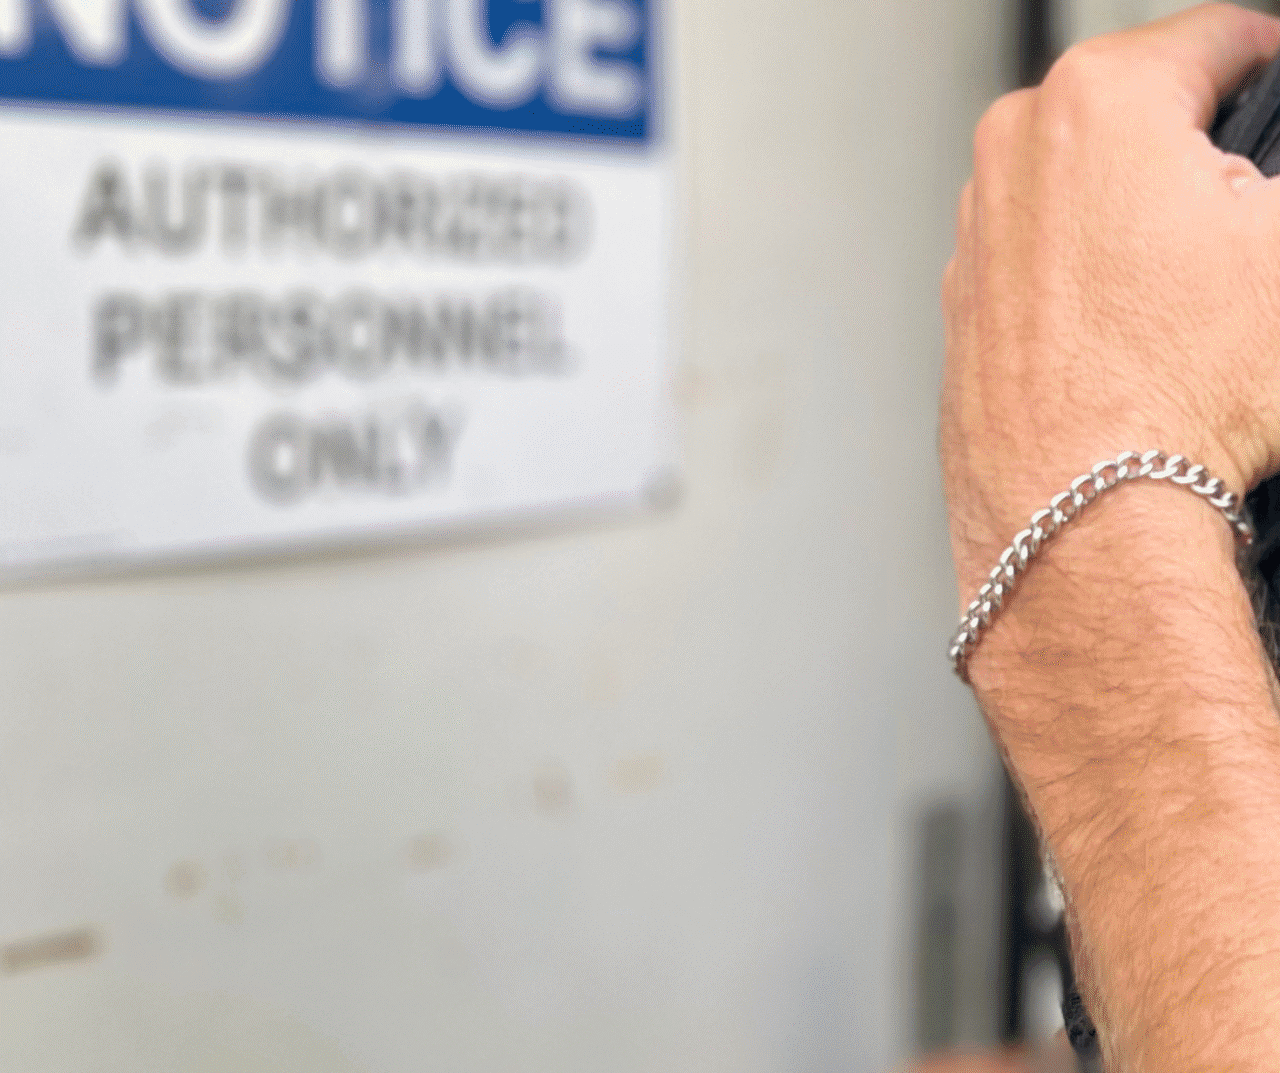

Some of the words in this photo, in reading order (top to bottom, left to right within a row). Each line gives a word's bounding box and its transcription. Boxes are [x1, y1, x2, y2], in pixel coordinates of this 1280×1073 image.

[72, 160, 591, 263] AUTHORIZED
[90, 287, 576, 385] PERSONNEL
[246, 403, 462, 503] ONLY
